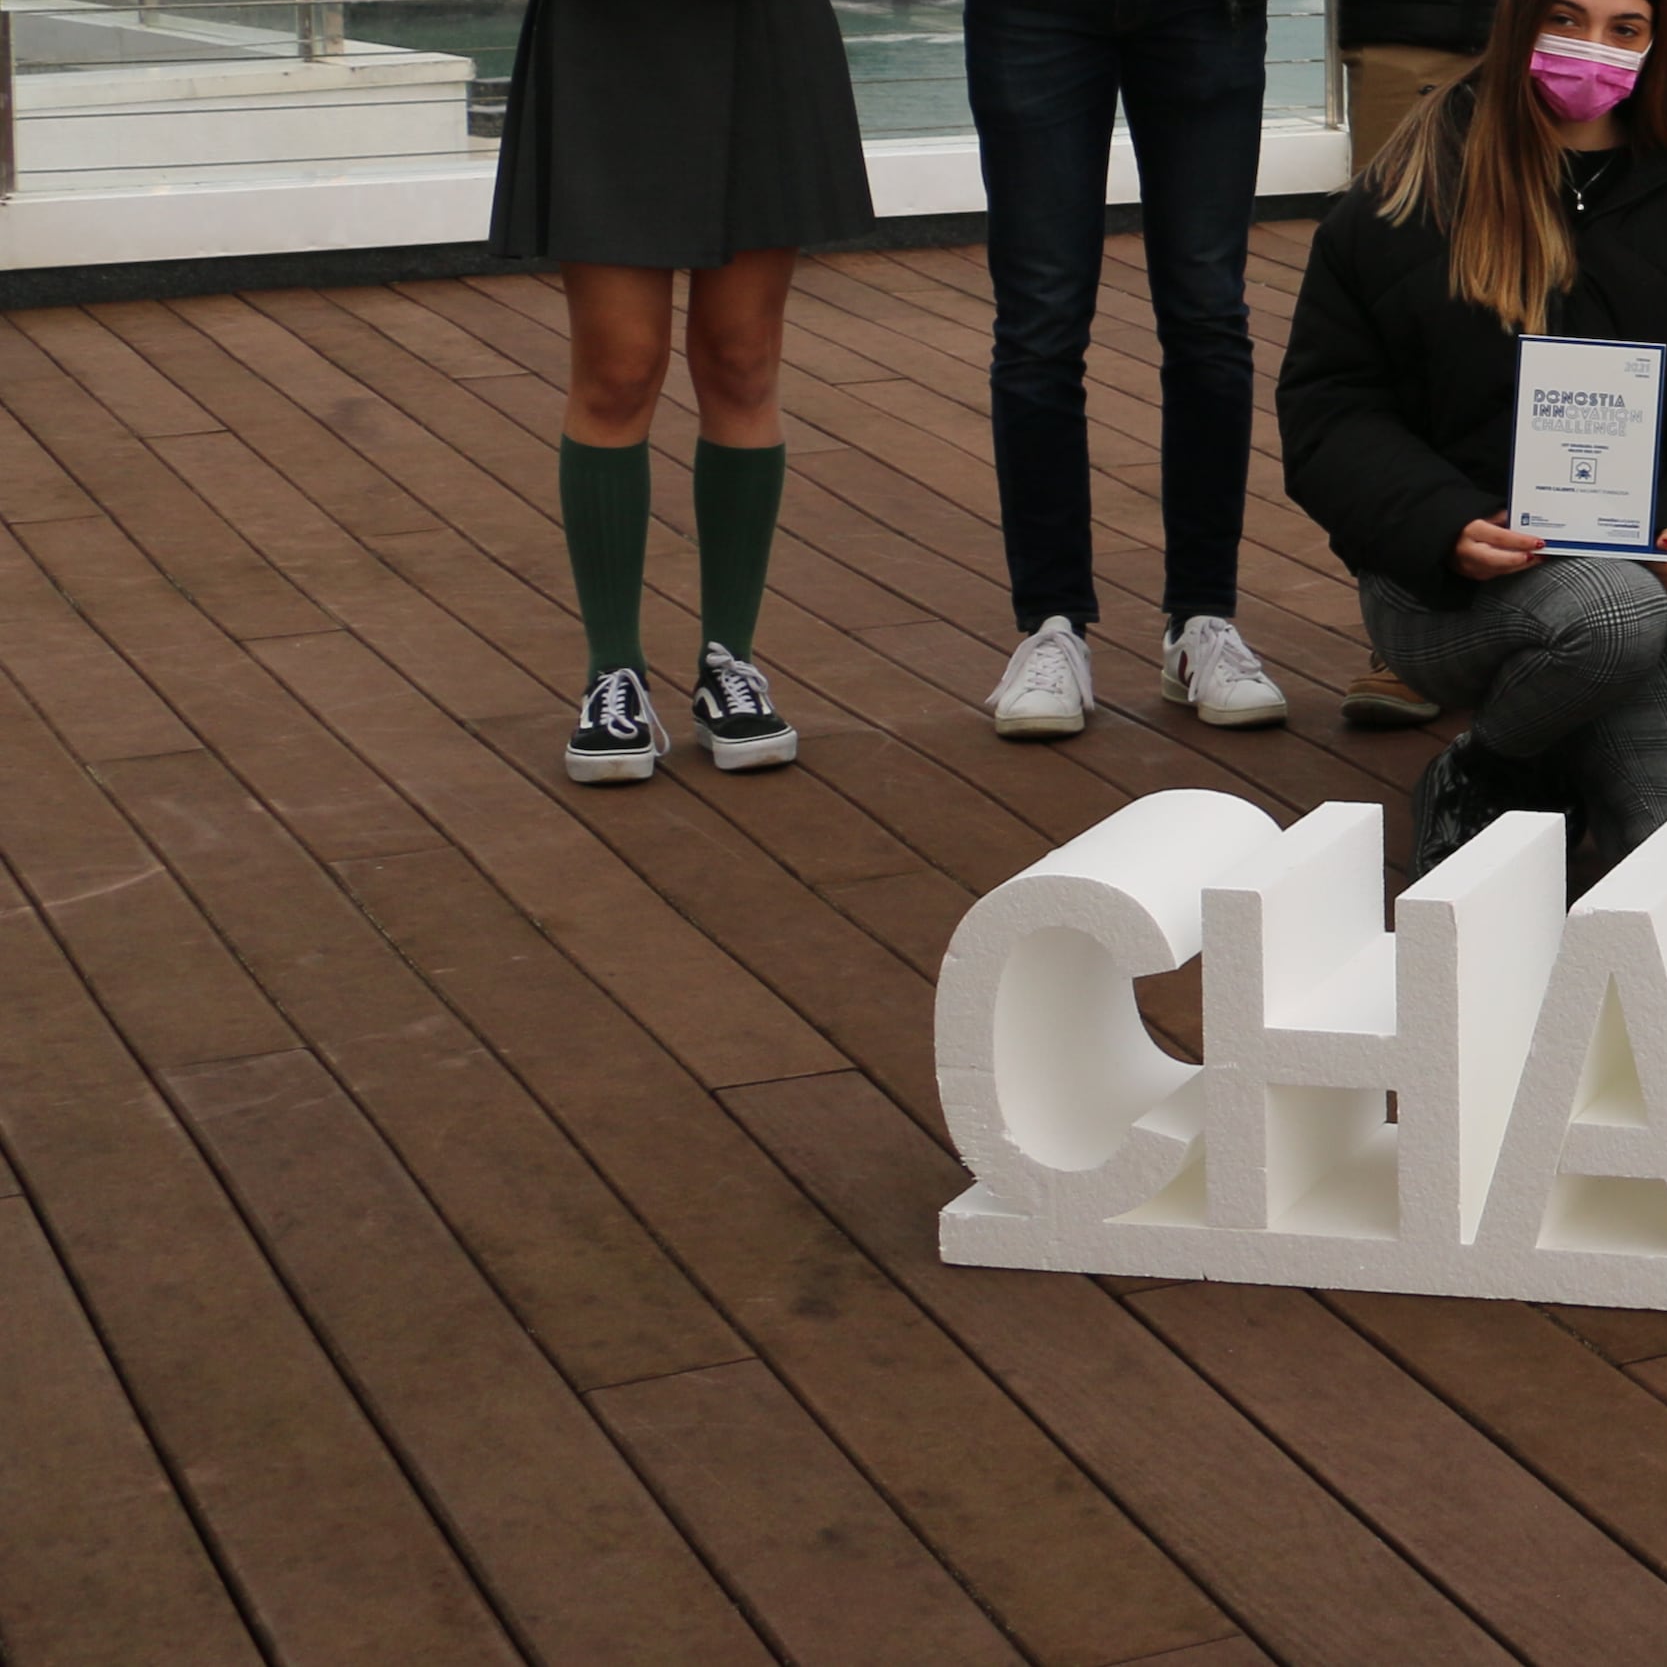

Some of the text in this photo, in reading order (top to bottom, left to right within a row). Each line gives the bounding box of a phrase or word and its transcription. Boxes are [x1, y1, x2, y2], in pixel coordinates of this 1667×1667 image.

[1534, 389, 1625, 407] DONOSTIA
[1533, 404, 1643, 422] INNOVATION
[1531, 418, 1626, 437] CHALLENGE
